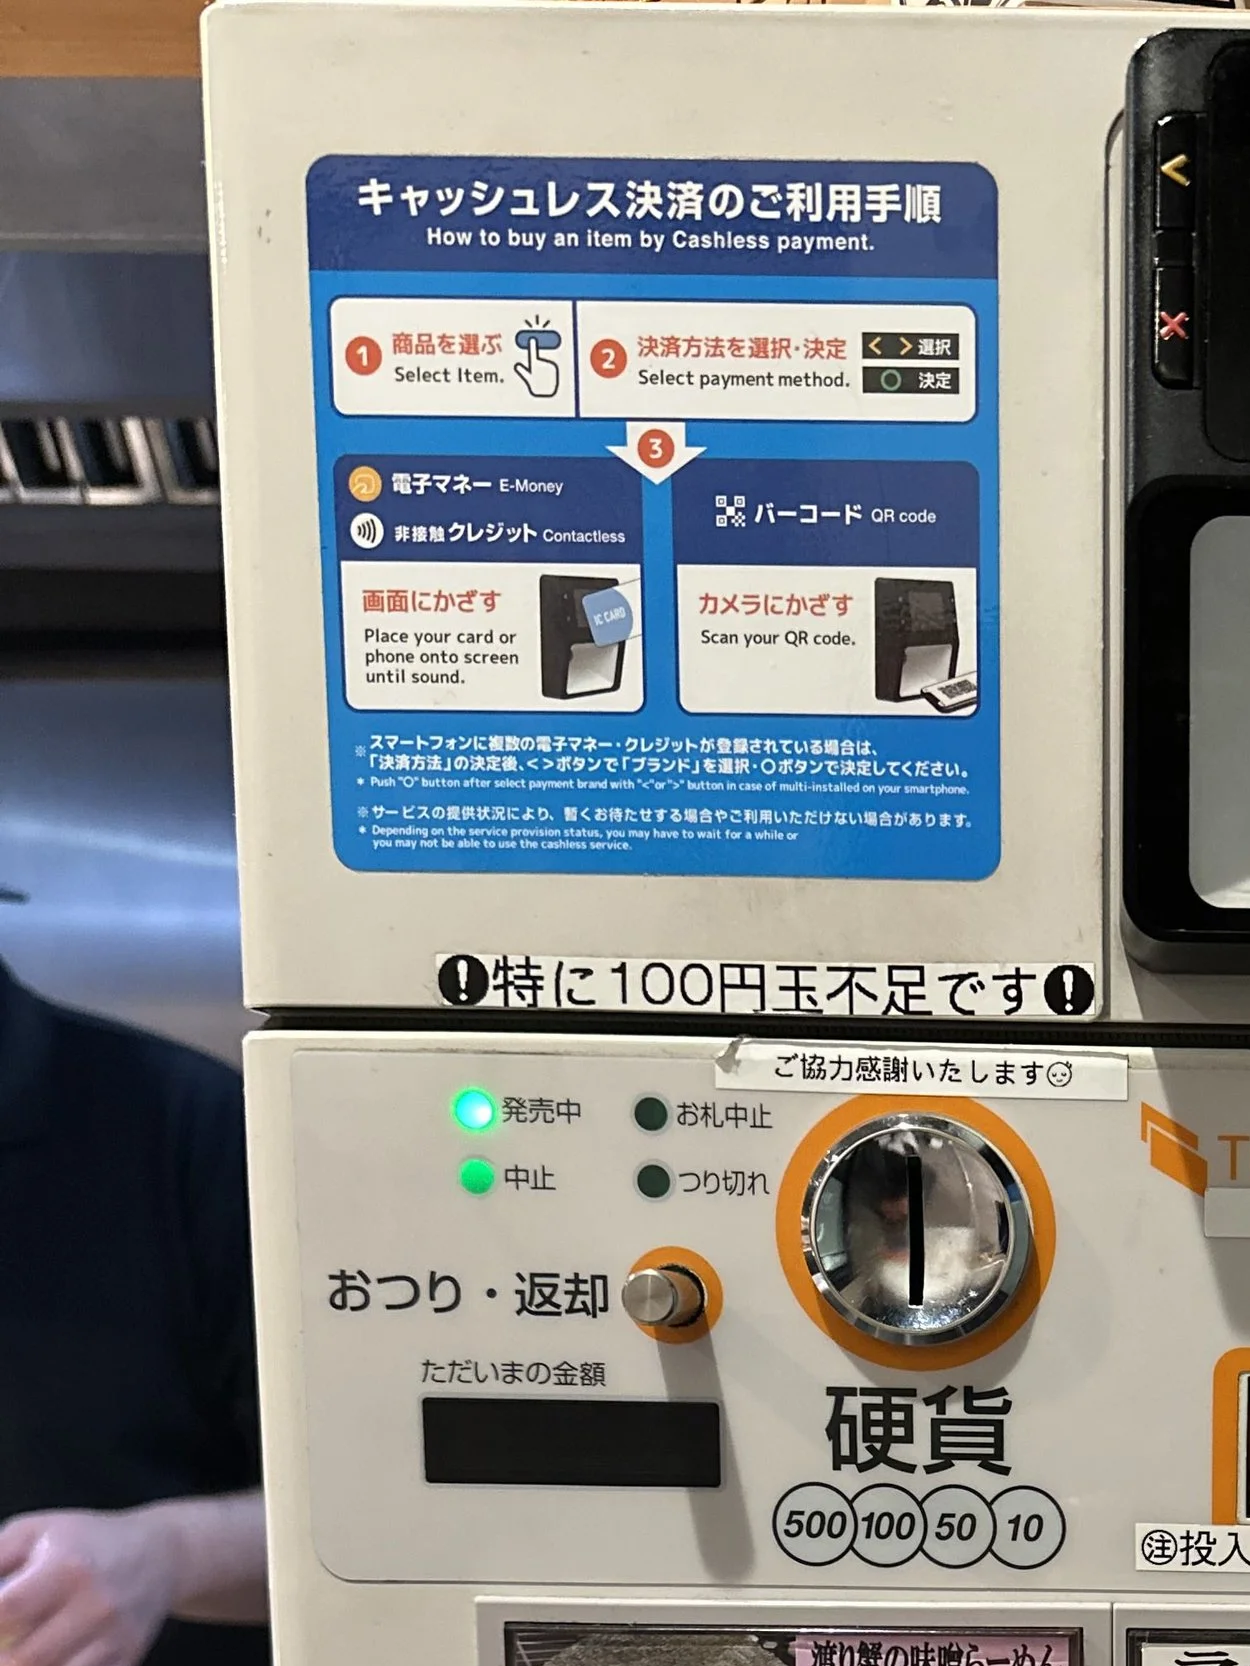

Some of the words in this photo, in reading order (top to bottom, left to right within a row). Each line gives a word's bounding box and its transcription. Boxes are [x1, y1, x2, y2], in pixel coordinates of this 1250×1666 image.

[358, 179, 940, 224] キャッシュレス決済のご利用手順
[427, 227, 473, 247] How
[480, 229, 501, 247] to
[507, 228, 547, 253] buy
[555, 231, 581, 249] an
[587, 228, 633, 249] item
[640, 229, 665, 253] by
[673, 229, 769, 251] Cashless
[778, 232, 875, 254] payment.
[391, 332, 502, 358] 商品を選ぶ
[918, 338, 952, 357] 選択
[394, 366, 451, 384] Select
[458, 366, 505, 384] Item.
[638, 368, 694, 387] Select
[699, 369, 774, 390] payment
[779, 370, 851, 389] method.
[918, 371, 952, 390] 決定
[392, 472, 492, 495] 電子マネー
[499, 478, 563, 496] E-Money
[754, 504, 862, 525] バーコード
[871, 509, 894, 523] QR
[899, 509, 936, 524] code
[543, 528, 626, 544] Contactless
[362, 589, 502, 613] 画面にかざす
[699, 592, 853, 617] カメラにかざす
[364, 628, 408, 643] Place
[414, 630, 451, 647] your
[457, 629, 493, 644] card
[499, 632, 516, 644] or
[701, 630, 738, 644] Scan
[743, 633, 780, 648] your
[784, 631, 808, 647] QR
[814, 631, 856, 646] code.
[365, 650, 415, 667] phone
[420, 651, 458, 665] onto
[464, 652, 519, 665] screen
[366, 669, 405, 684] until
[412, 669, 465, 684] sound.
[372, 839, 391, 851] you
[394, 839, 417, 850] may
[420, 838, 439, 848] not
[442, 838, 454, 848] be
[457, 838, 480, 848] able
[483, 838, 495, 848] to
[498, 840, 516, 849] use
[520, 838, 538, 849] the
[541, 838, 586, 849] cashless
[590, 839, 632, 851] service.
[501, 1098, 581, 1124] 発売中
[676, 1101, 773, 1130] お札中止
[504, 1164, 557, 1191] 中止
[678, 1169, 770, 1196] つり切れ
[327, 1270, 610, 1319] おつり・返却
[421, 1358, 607, 1387] ただいまの金額
[825, 1385, 1012, 1476] 硬貨
[784, 1510, 847, 1539] 500
[861, 1511, 916, 1541] 100
[935, 1512, 976, 1541] 50
[1008, 1514, 1044, 1542] 10
